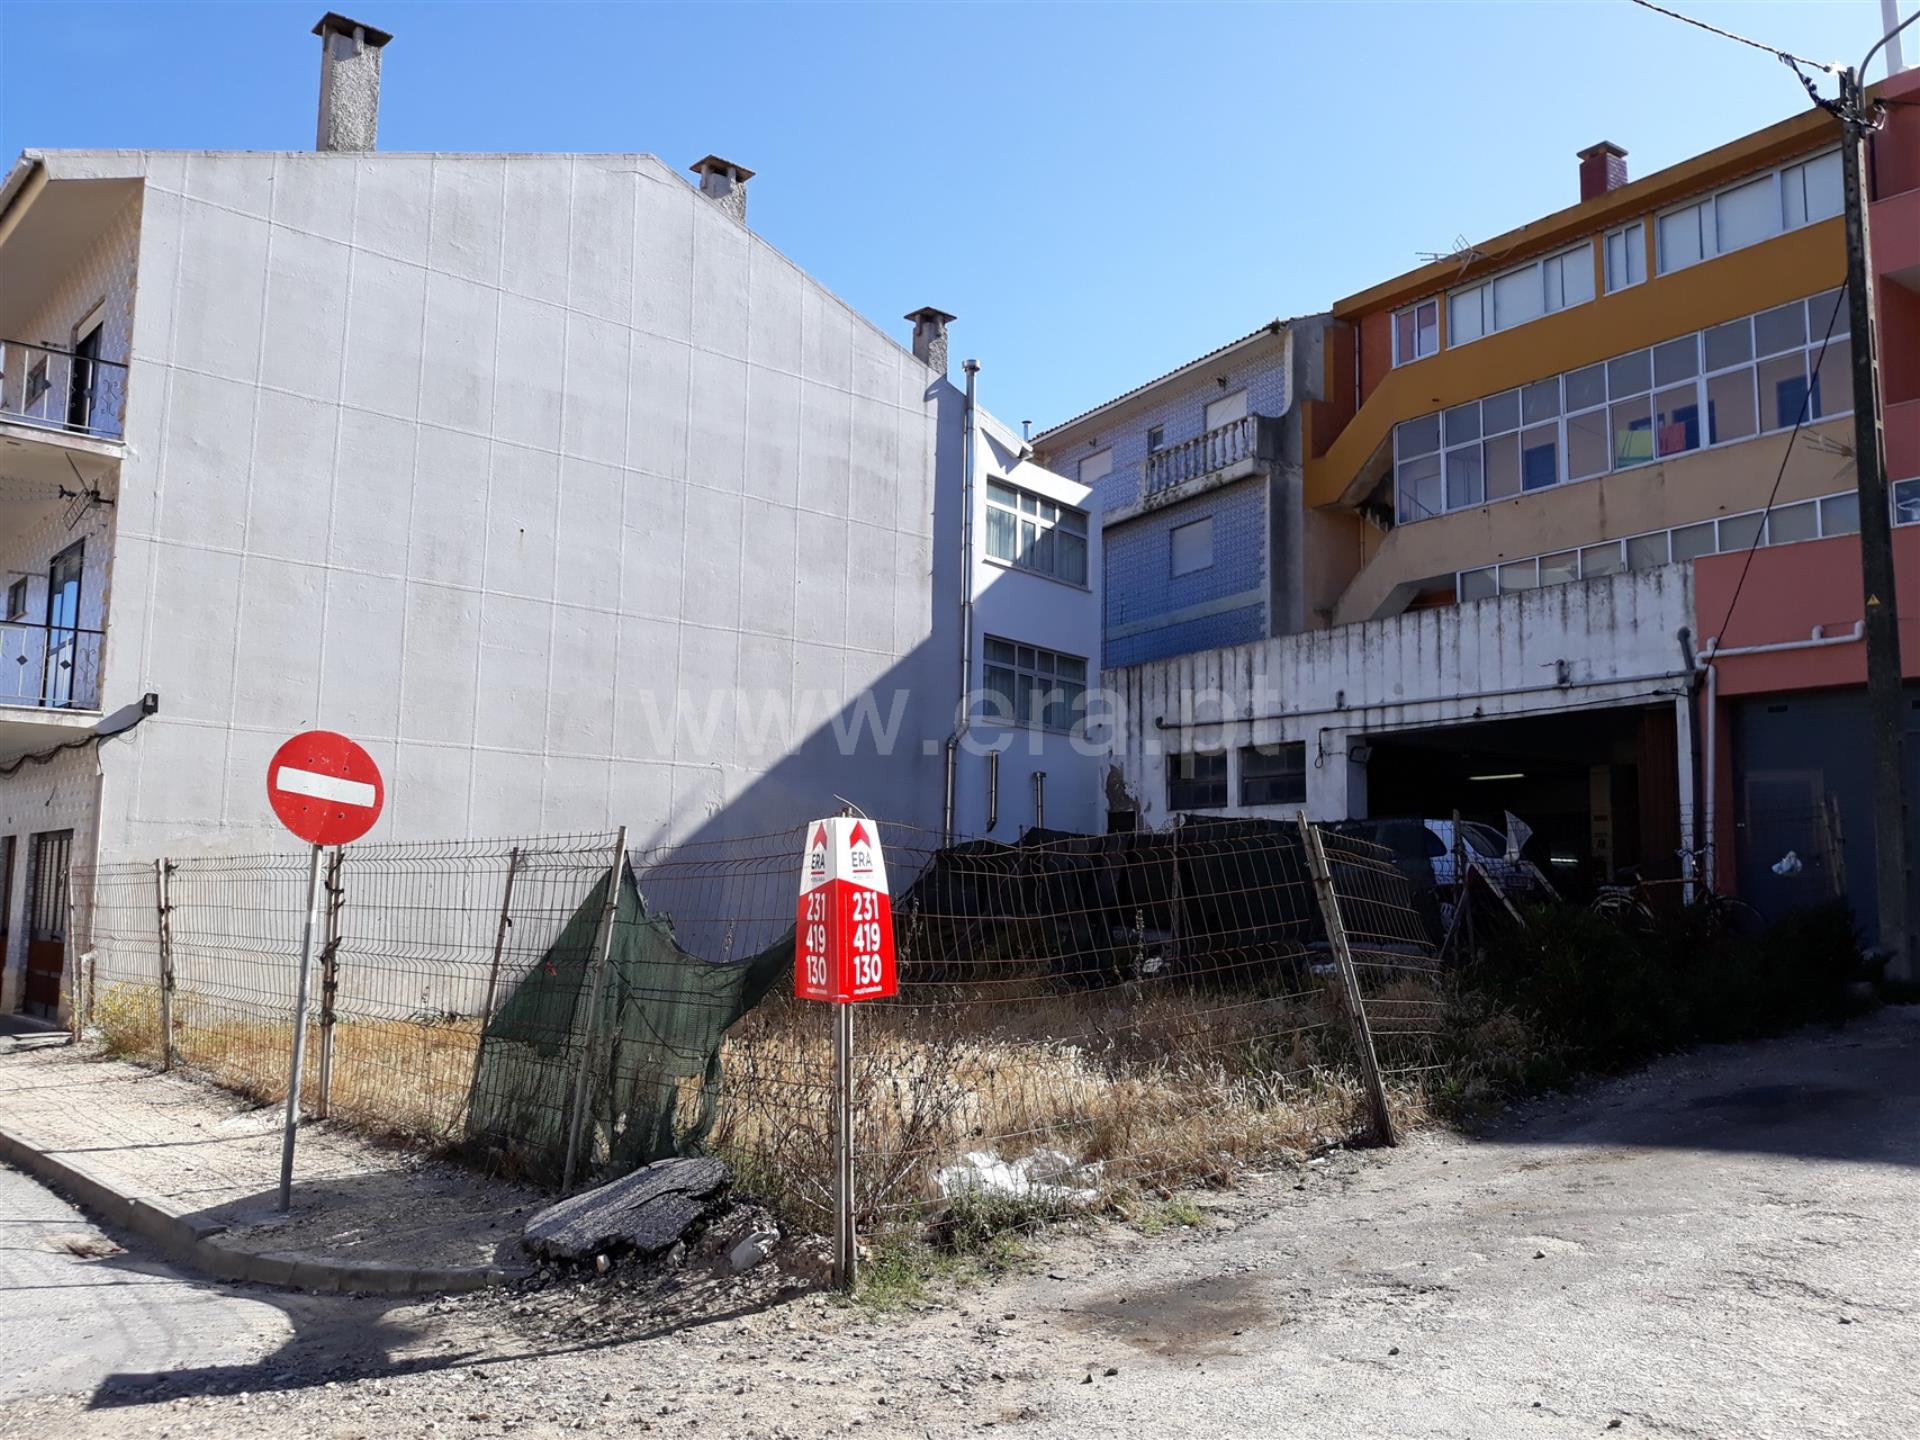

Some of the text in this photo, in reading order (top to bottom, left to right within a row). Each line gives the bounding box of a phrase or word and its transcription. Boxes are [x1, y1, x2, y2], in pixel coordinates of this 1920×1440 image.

[811, 853, 825, 870] ERA
[851, 851, 873, 867] ERA
[806, 892, 826, 921] 231
[852, 891, 879, 921] 231
[805, 924, 826, 954] 419
[853, 922, 881, 952] 419
[805, 955, 827, 986] 130
[853, 953, 882, 986] 130
